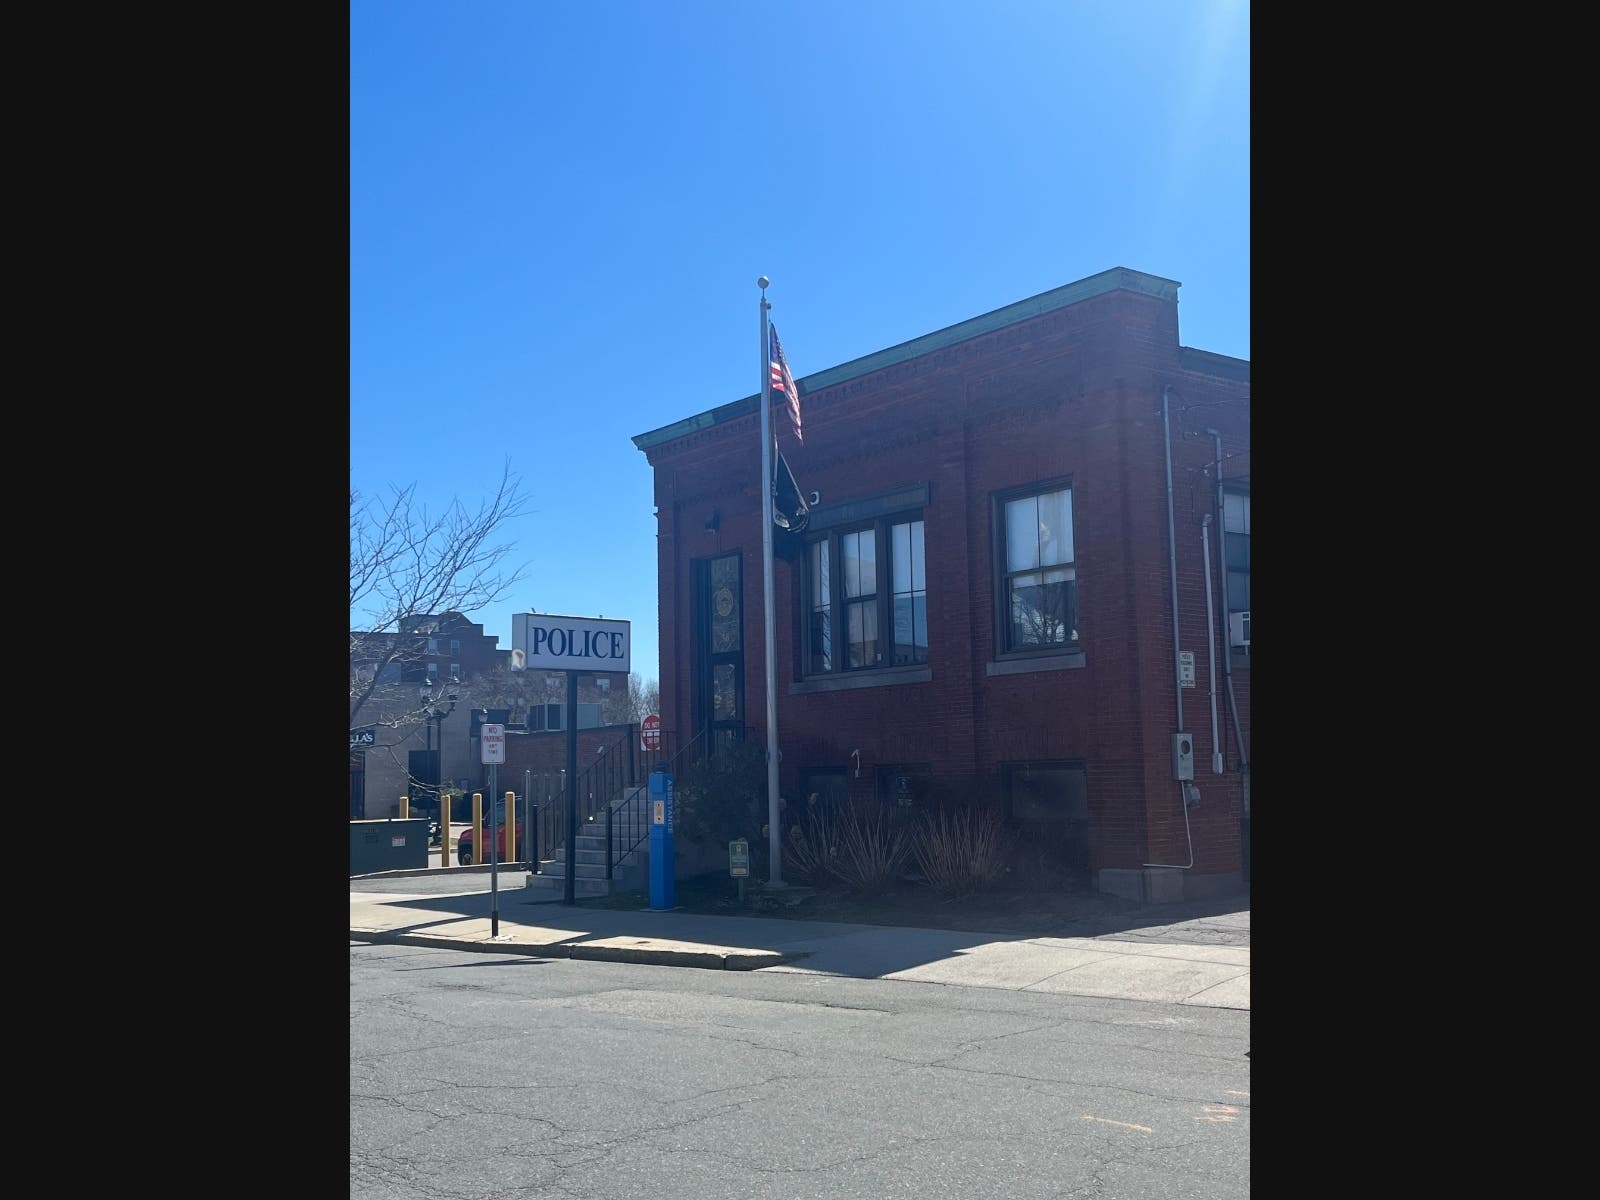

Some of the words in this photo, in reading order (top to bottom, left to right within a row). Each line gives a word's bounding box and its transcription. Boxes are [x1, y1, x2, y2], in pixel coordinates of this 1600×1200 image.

[532, 626, 625, 659] POLICE
[651, 721, 660, 729] NOT
[488, 727, 498, 735] NO
[483, 735, 504, 743] PARKING
